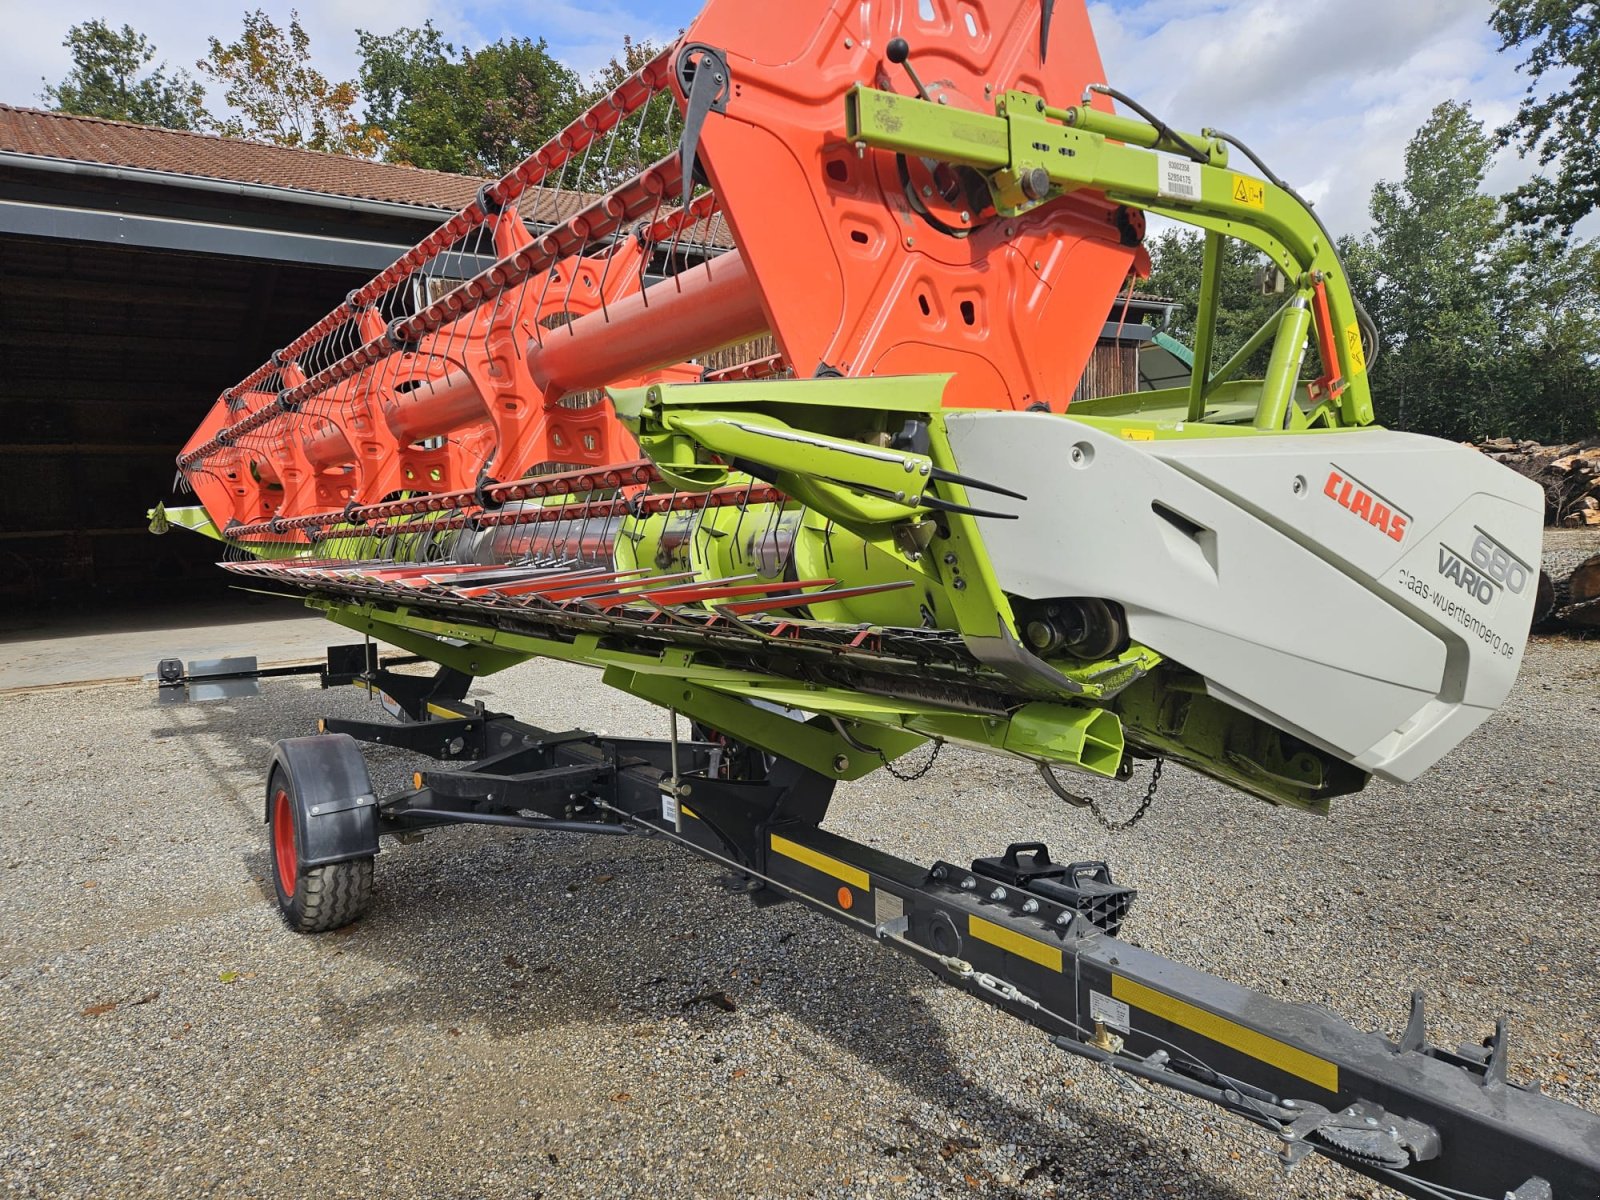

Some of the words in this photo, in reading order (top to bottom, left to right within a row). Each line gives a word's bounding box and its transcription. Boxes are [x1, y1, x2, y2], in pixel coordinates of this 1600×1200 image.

[1323, 471, 1407, 542] CLAAS
[1438, 548, 1494, 605] VARIO
[1470, 535, 1527, 594] 680
